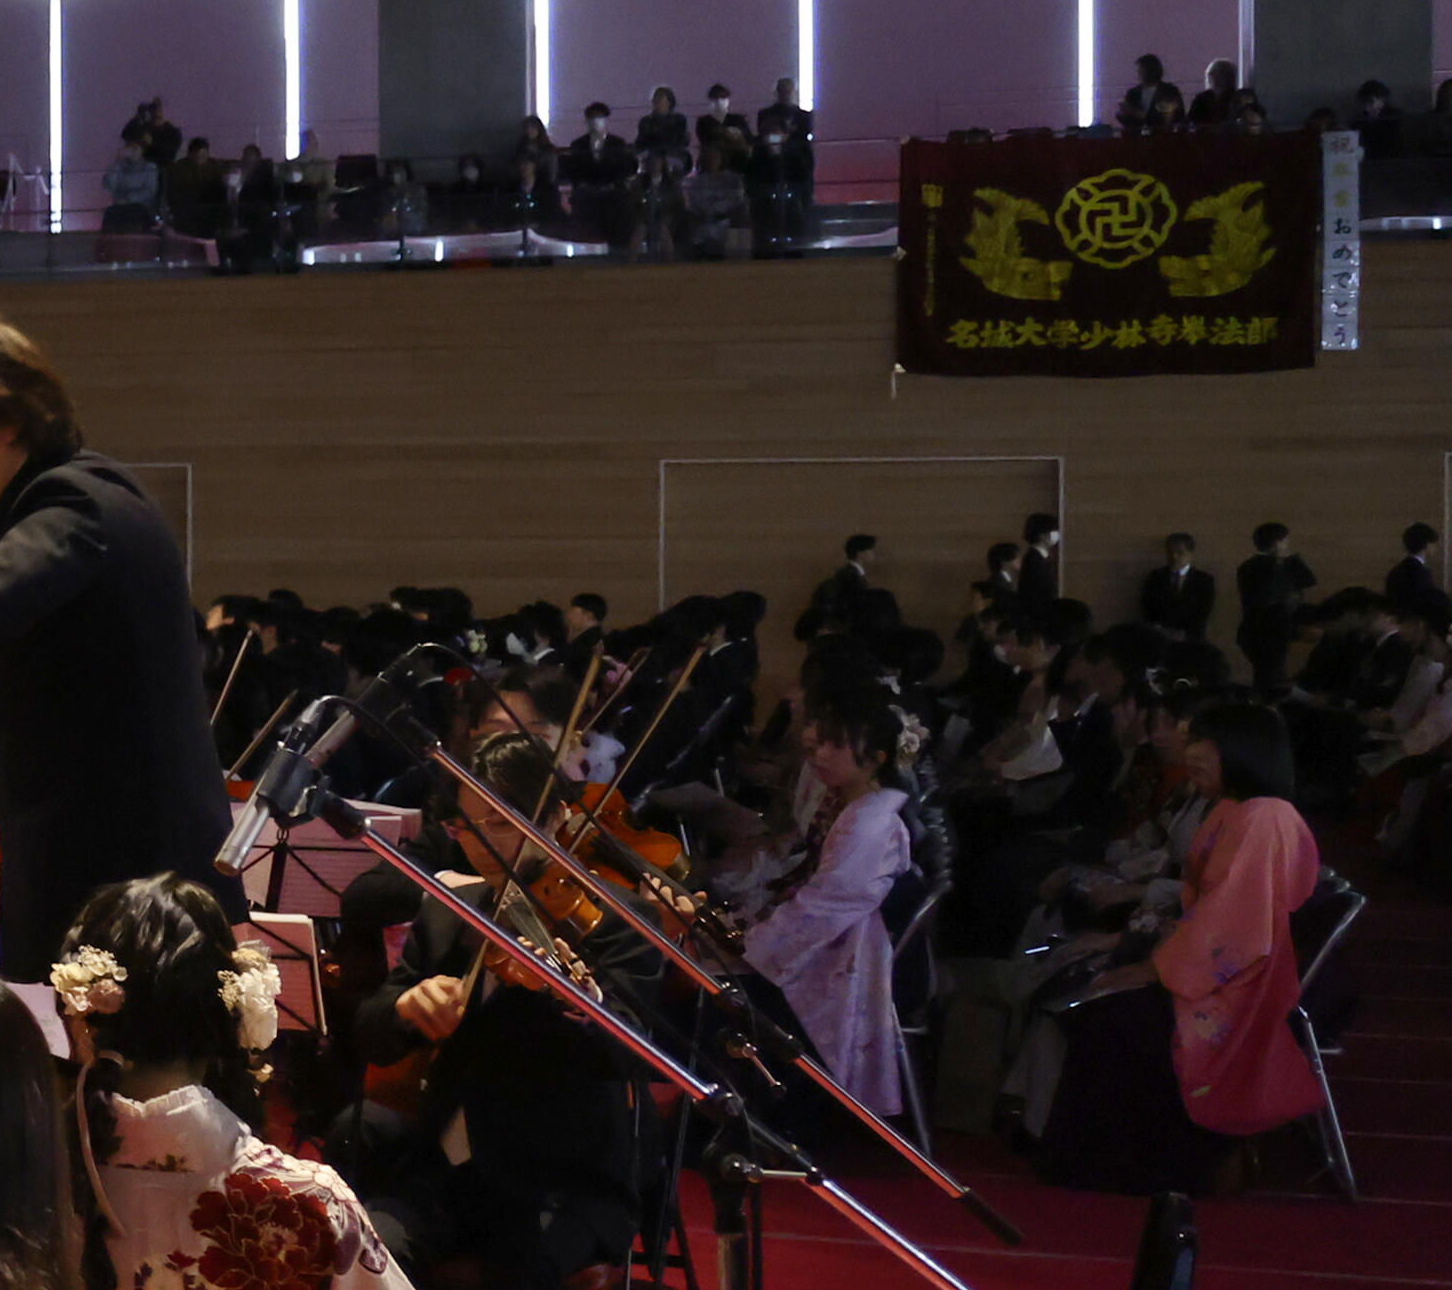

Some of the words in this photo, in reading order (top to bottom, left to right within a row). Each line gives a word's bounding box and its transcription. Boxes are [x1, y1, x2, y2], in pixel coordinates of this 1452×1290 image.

[946, 314, 1278, 350] 名城大学少林寺拳法部
